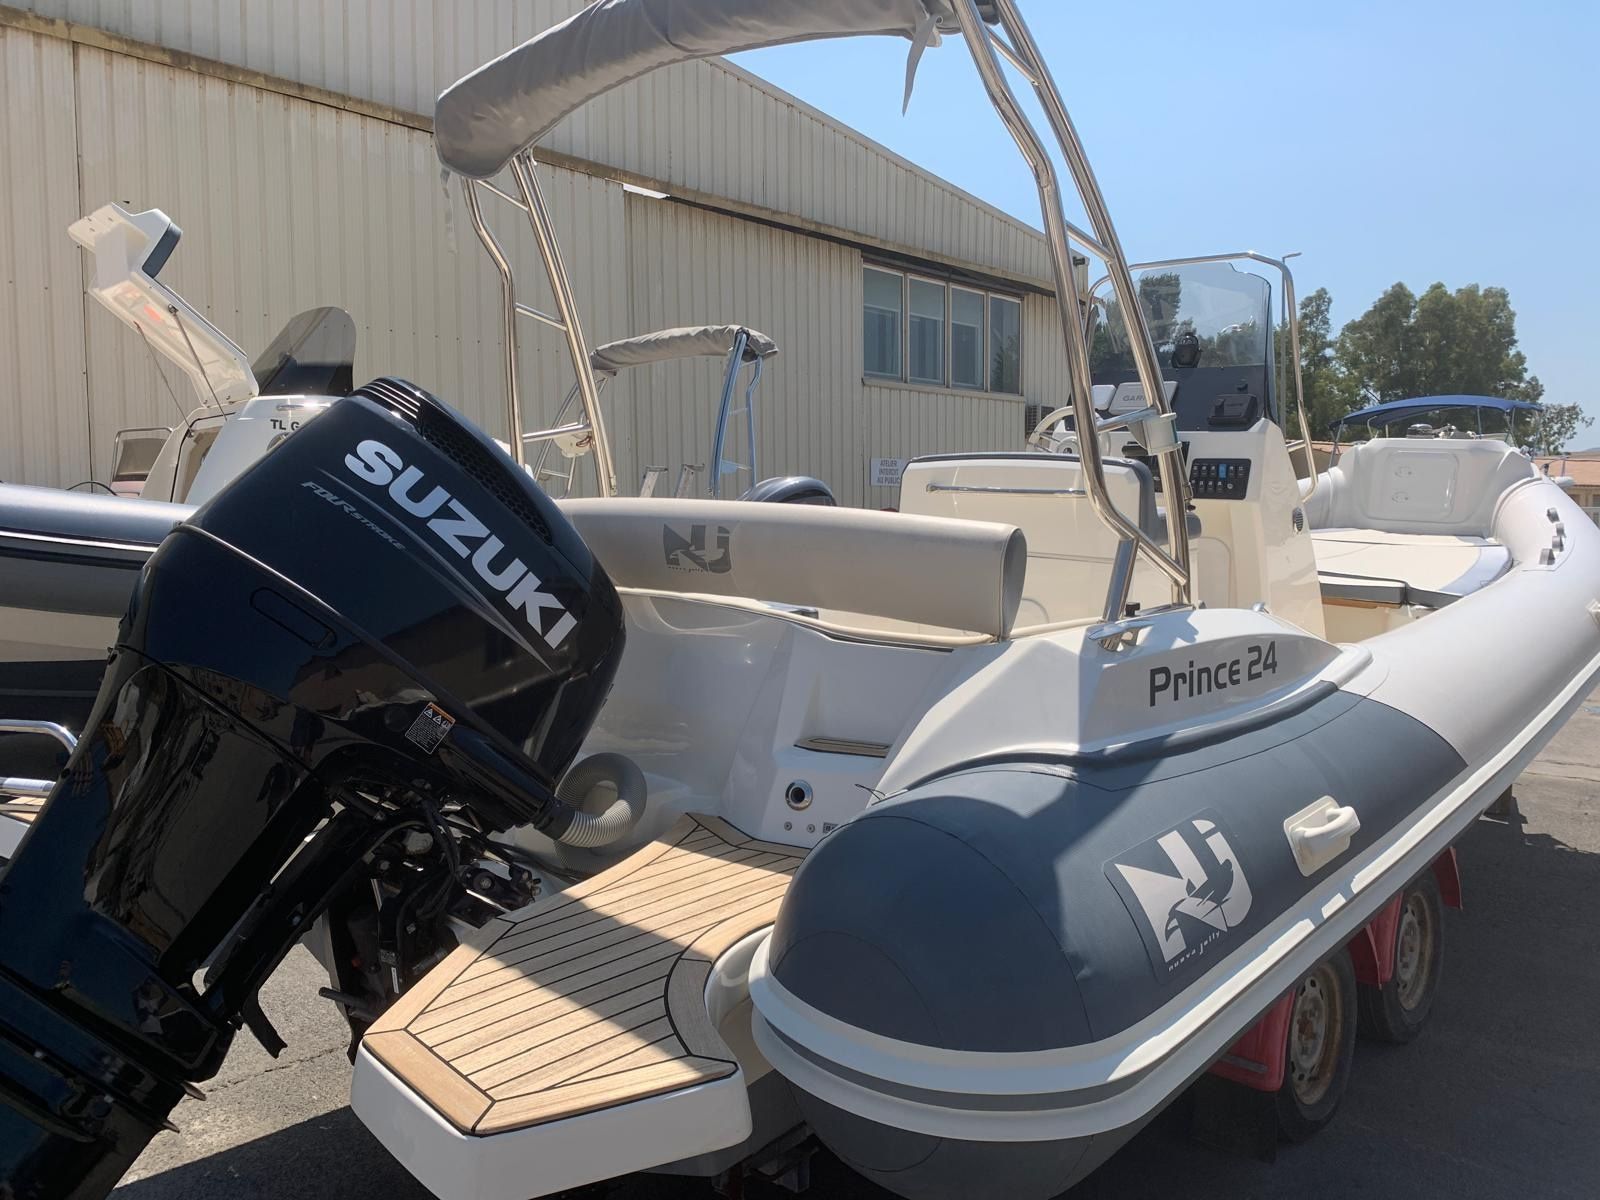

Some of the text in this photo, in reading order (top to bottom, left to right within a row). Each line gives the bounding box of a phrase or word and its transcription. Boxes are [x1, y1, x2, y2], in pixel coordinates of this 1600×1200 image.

[1122, 394, 1145, 402] GAR
[270, 419, 286, 430] TL
[344, 440, 578, 650] SUZUKI
[1149, 641, 1277, 707] Prince 24
